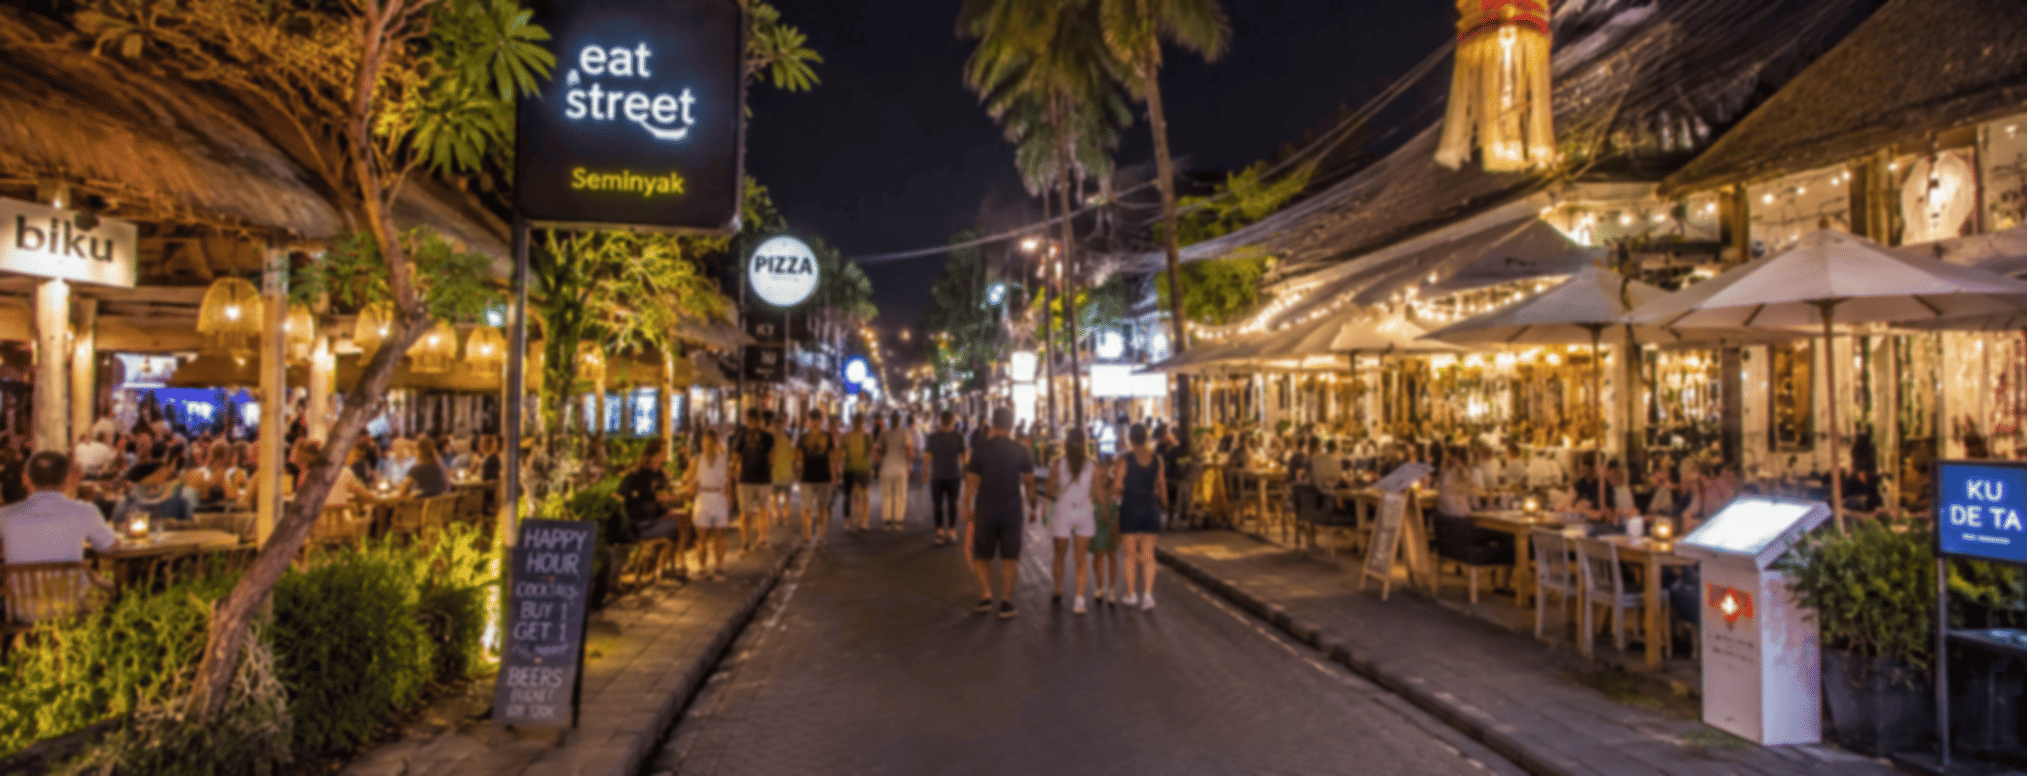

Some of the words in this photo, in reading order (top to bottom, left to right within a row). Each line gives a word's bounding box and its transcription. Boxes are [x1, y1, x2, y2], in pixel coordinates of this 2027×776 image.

[579, 42, 652, 78] eat
[565, 82, 696, 128] street
[571, 166, 686, 197] Seminyak
[15, 213, 114, 263] biku
[754, 255, 813, 275] PIZZA
[1966, 478, 2004, 502] KU
[1950, 503, 1983, 528] DE
[1988, 506, 2023, 532] TA
[523, 527, 588, 551] HAPPY
[525, 552, 580, 575] HOUR
[520, 600, 554, 620] BUY
[513, 620, 553, 641] GET
[506, 665, 564, 689] BEERS
